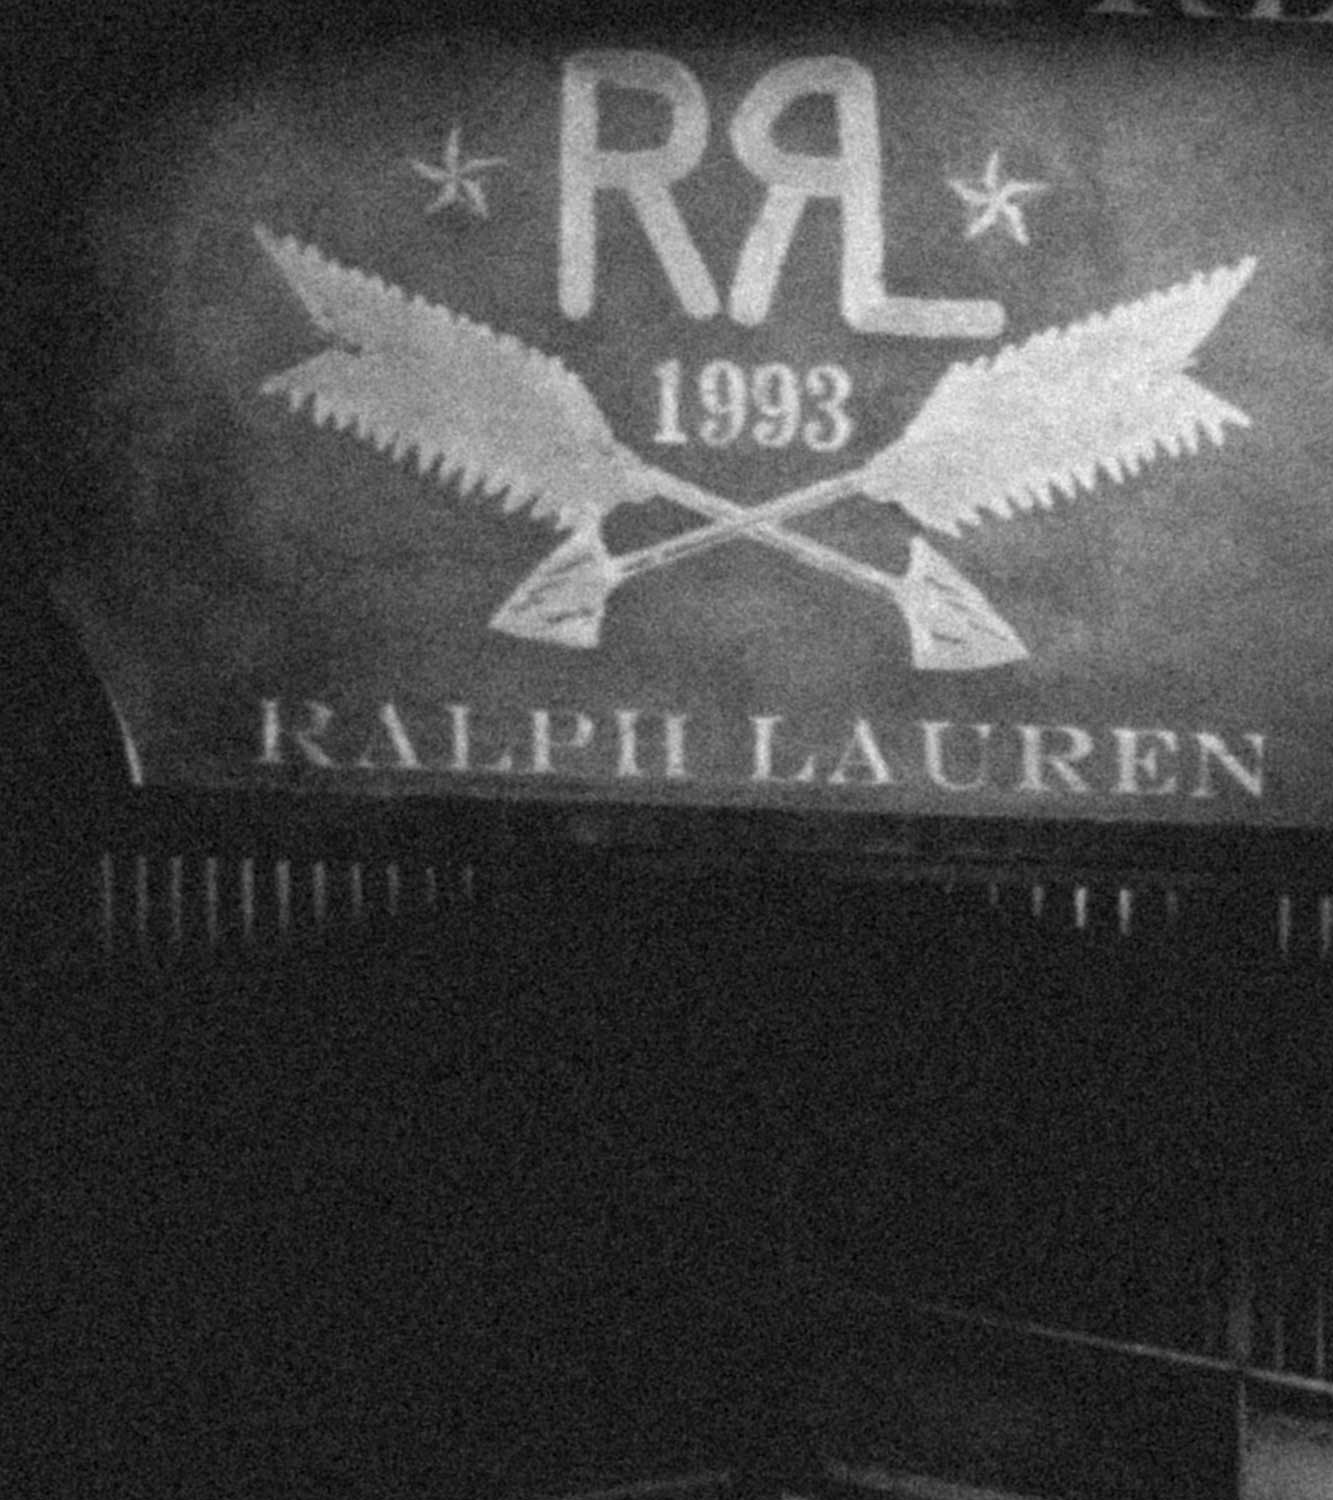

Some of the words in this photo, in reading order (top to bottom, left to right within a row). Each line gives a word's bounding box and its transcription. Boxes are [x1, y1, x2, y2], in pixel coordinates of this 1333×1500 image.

[653, 358, 854, 453] 1993
[256, 697, 690, 779] RALPH
[748, 714, 1268, 799] LAUREN
